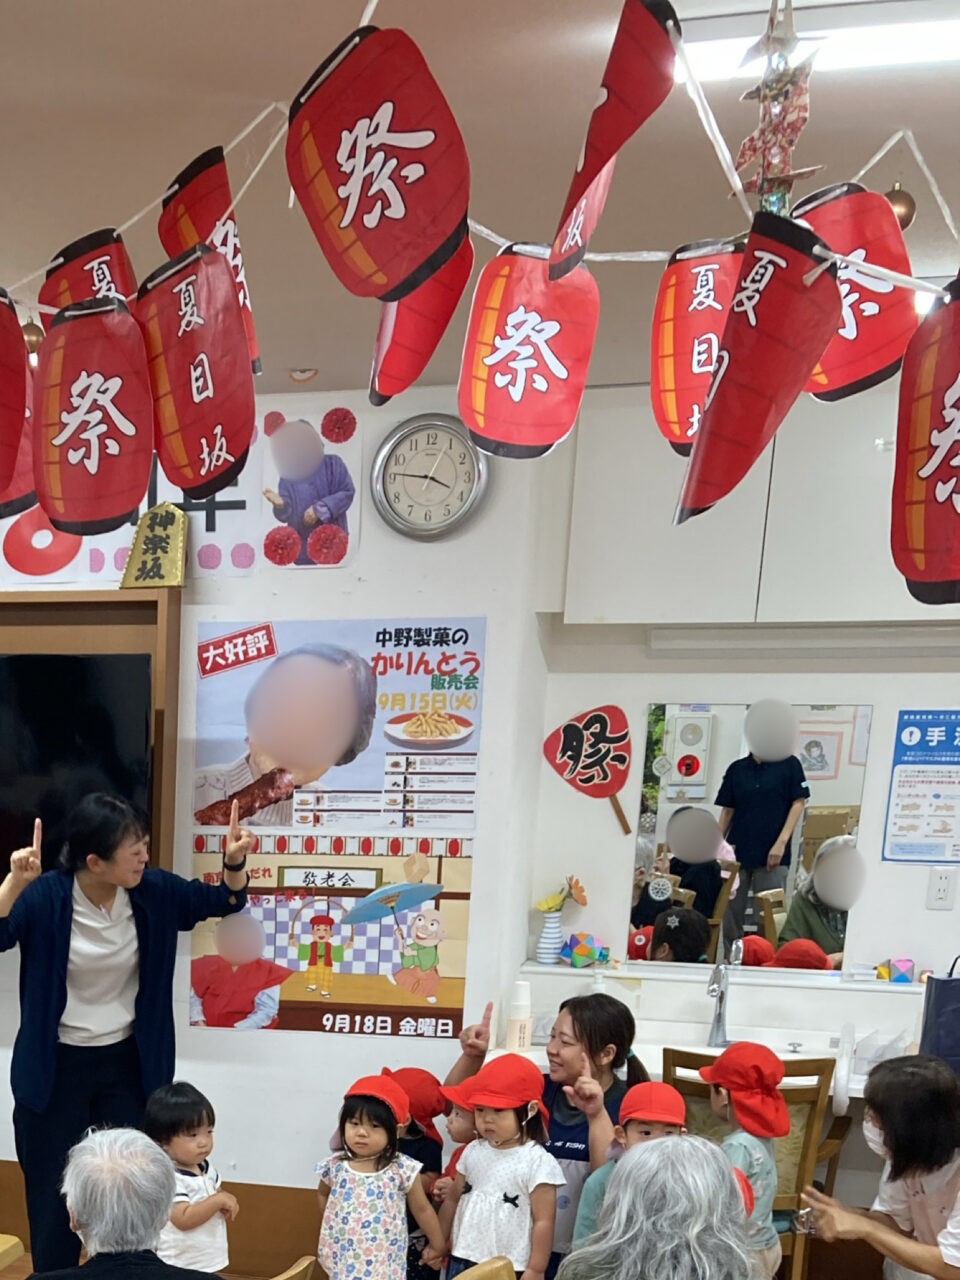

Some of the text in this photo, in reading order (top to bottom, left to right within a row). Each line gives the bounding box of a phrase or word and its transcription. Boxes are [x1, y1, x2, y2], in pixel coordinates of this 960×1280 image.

[337, 101, 436, 229] 祭
[483, 305, 570, 402] 祭
[172, 274, 235, 477] 夏目坂
[52, 370, 137, 475] 祭
[409, 439, 418, 451] 11
[426, 432, 438, 446] 12
[448, 437, 453, 450] 1
[394, 454, 406, 466] 10
[459, 452, 466, 465] 2
[389, 472, 396, 484] 9
[464, 471, 471, 483] 3
[393, 492, 400, 504] 8
[457, 490, 464, 502] 4
[407, 505, 414, 517] 7
[424, 510, 432, 522] 6
[443, 504, 450, 516] 5
[134, 511, 176, 581] 神楽坂
[375, 627, 469, 648] 中野製菓の
[202, 630, 270, 671] 大好評
[371, 651, 481, 676] かりんとう
[431, 674, 480, 691] 販売会
[557, 712, 630, 785] 祭
[302, 870, 355, 888] 敬老会
[322, 1013, 454, 1038] 9月18日 金曜日
